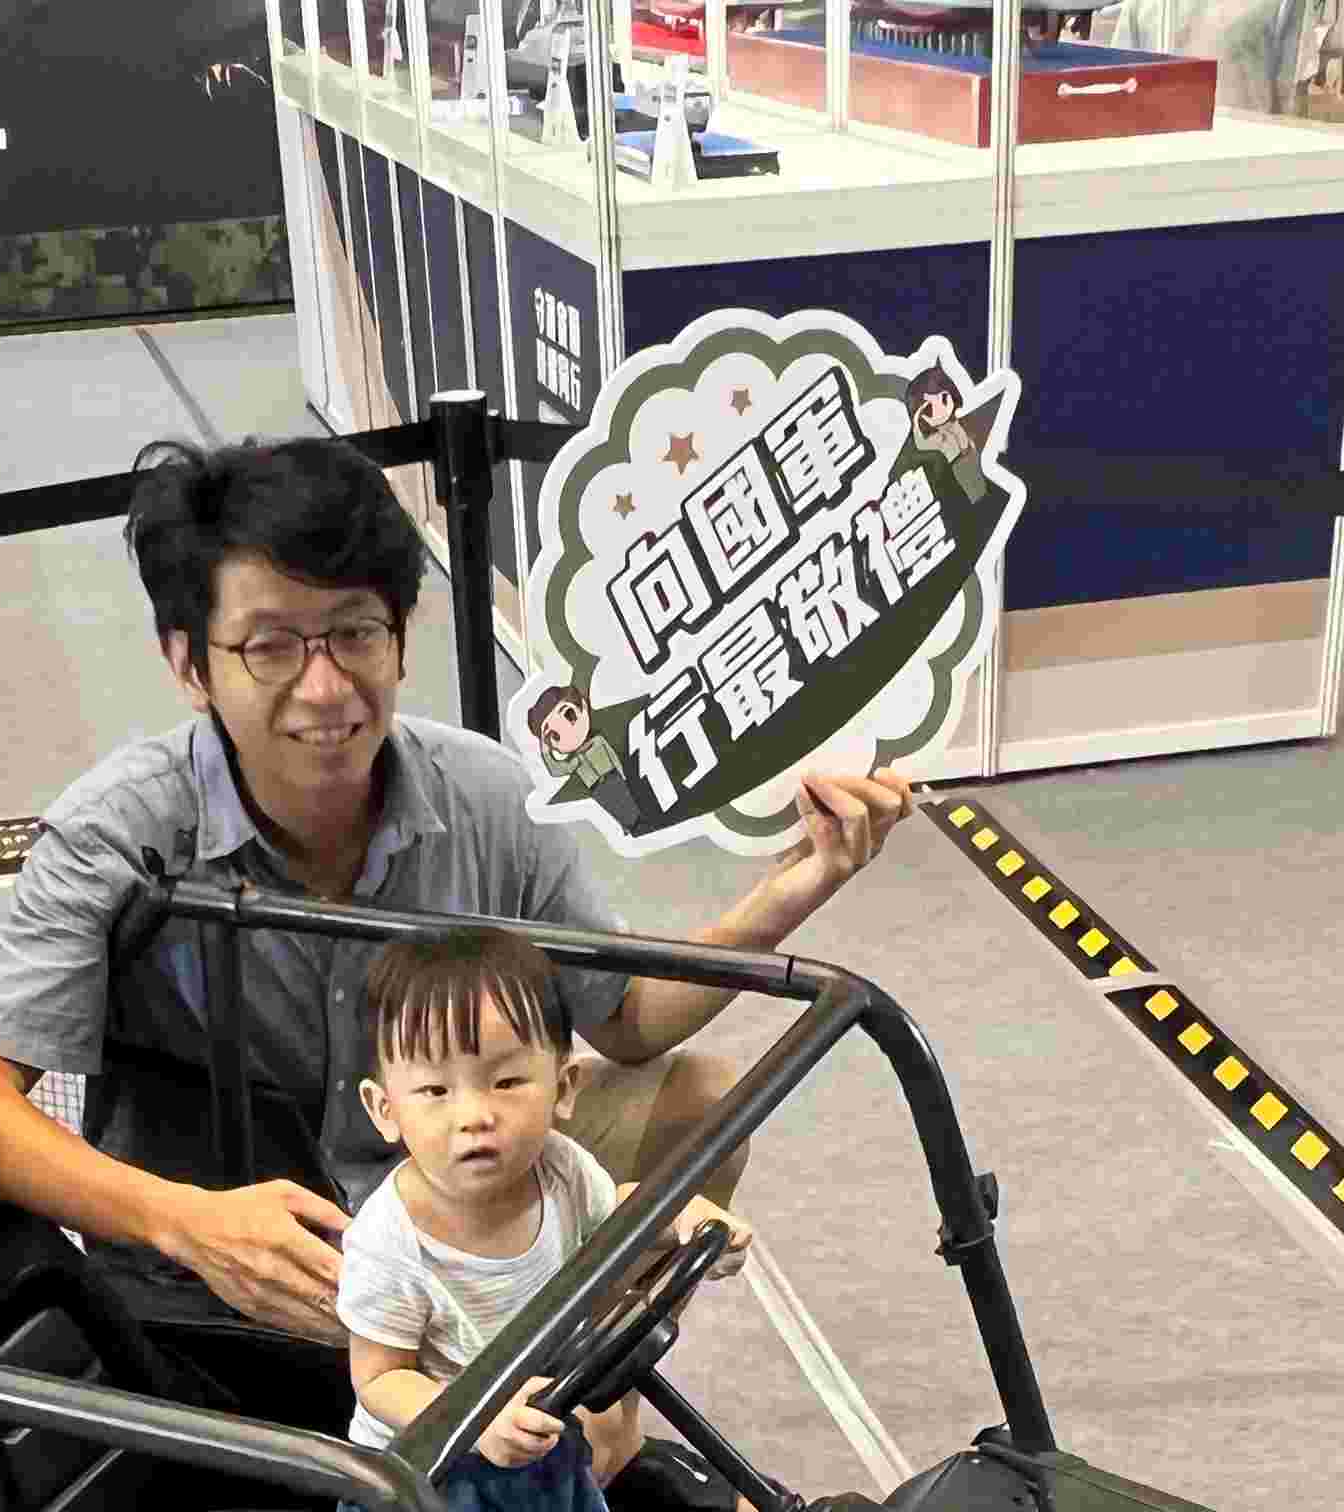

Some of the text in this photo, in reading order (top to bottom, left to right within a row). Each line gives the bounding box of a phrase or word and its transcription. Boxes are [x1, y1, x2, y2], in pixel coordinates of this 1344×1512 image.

[608, 369, 871, 671] 向國軍
[627, 467, 955, 812] 行最敬禮
